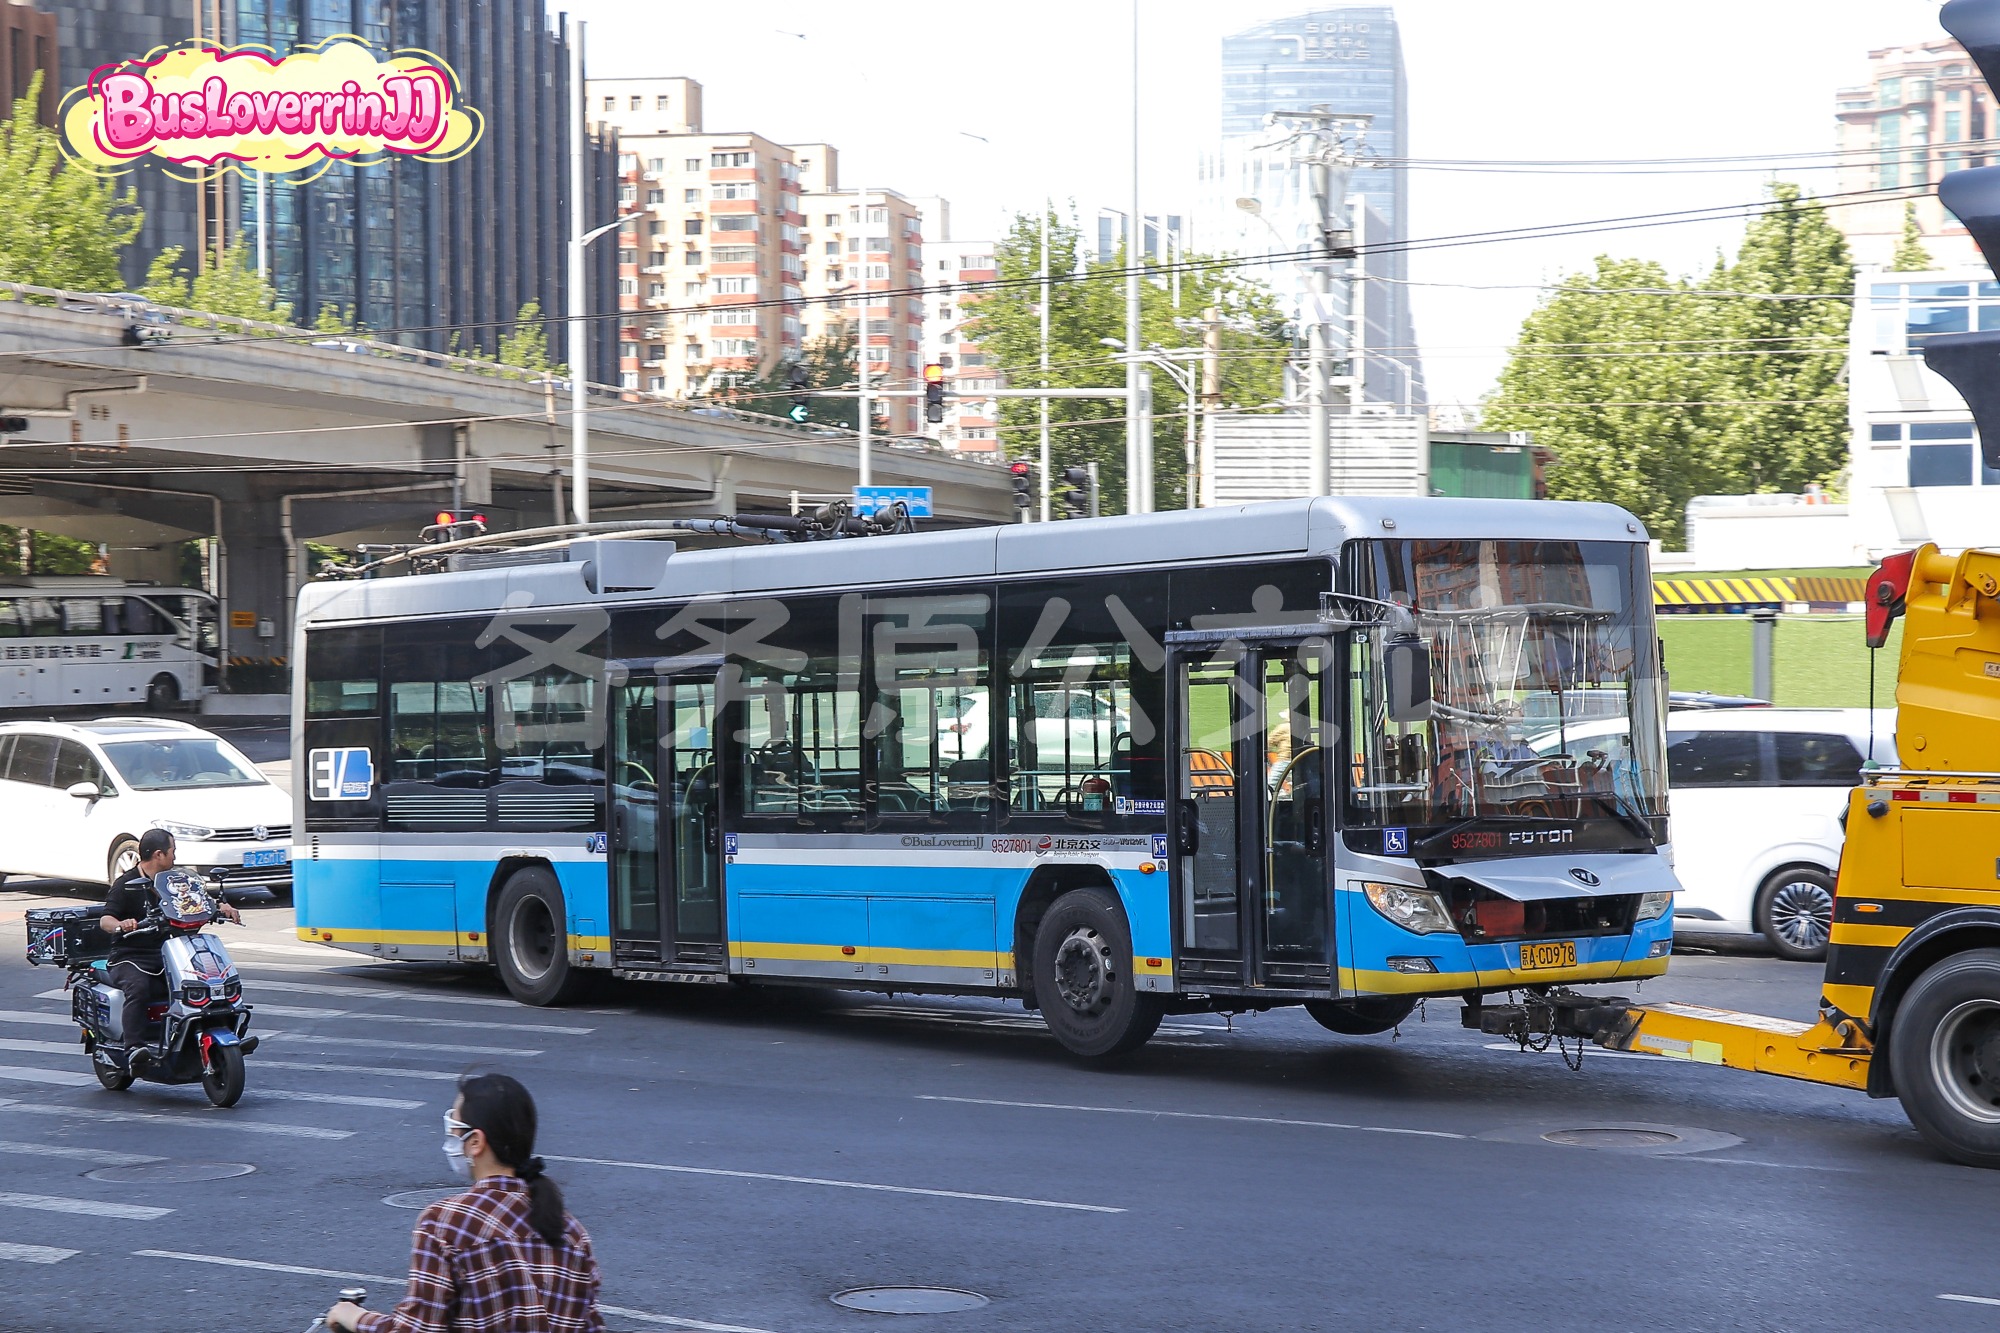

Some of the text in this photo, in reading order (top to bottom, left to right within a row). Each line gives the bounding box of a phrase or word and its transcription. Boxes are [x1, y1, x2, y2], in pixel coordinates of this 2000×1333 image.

[1305, 22, 1370, 33] SOHO
[1055, 838, 1101, 850] 北京公交
[1452, 829, 1573, 849] 9527801 FOTON
[991, 839, 1032, 853] 9527801
